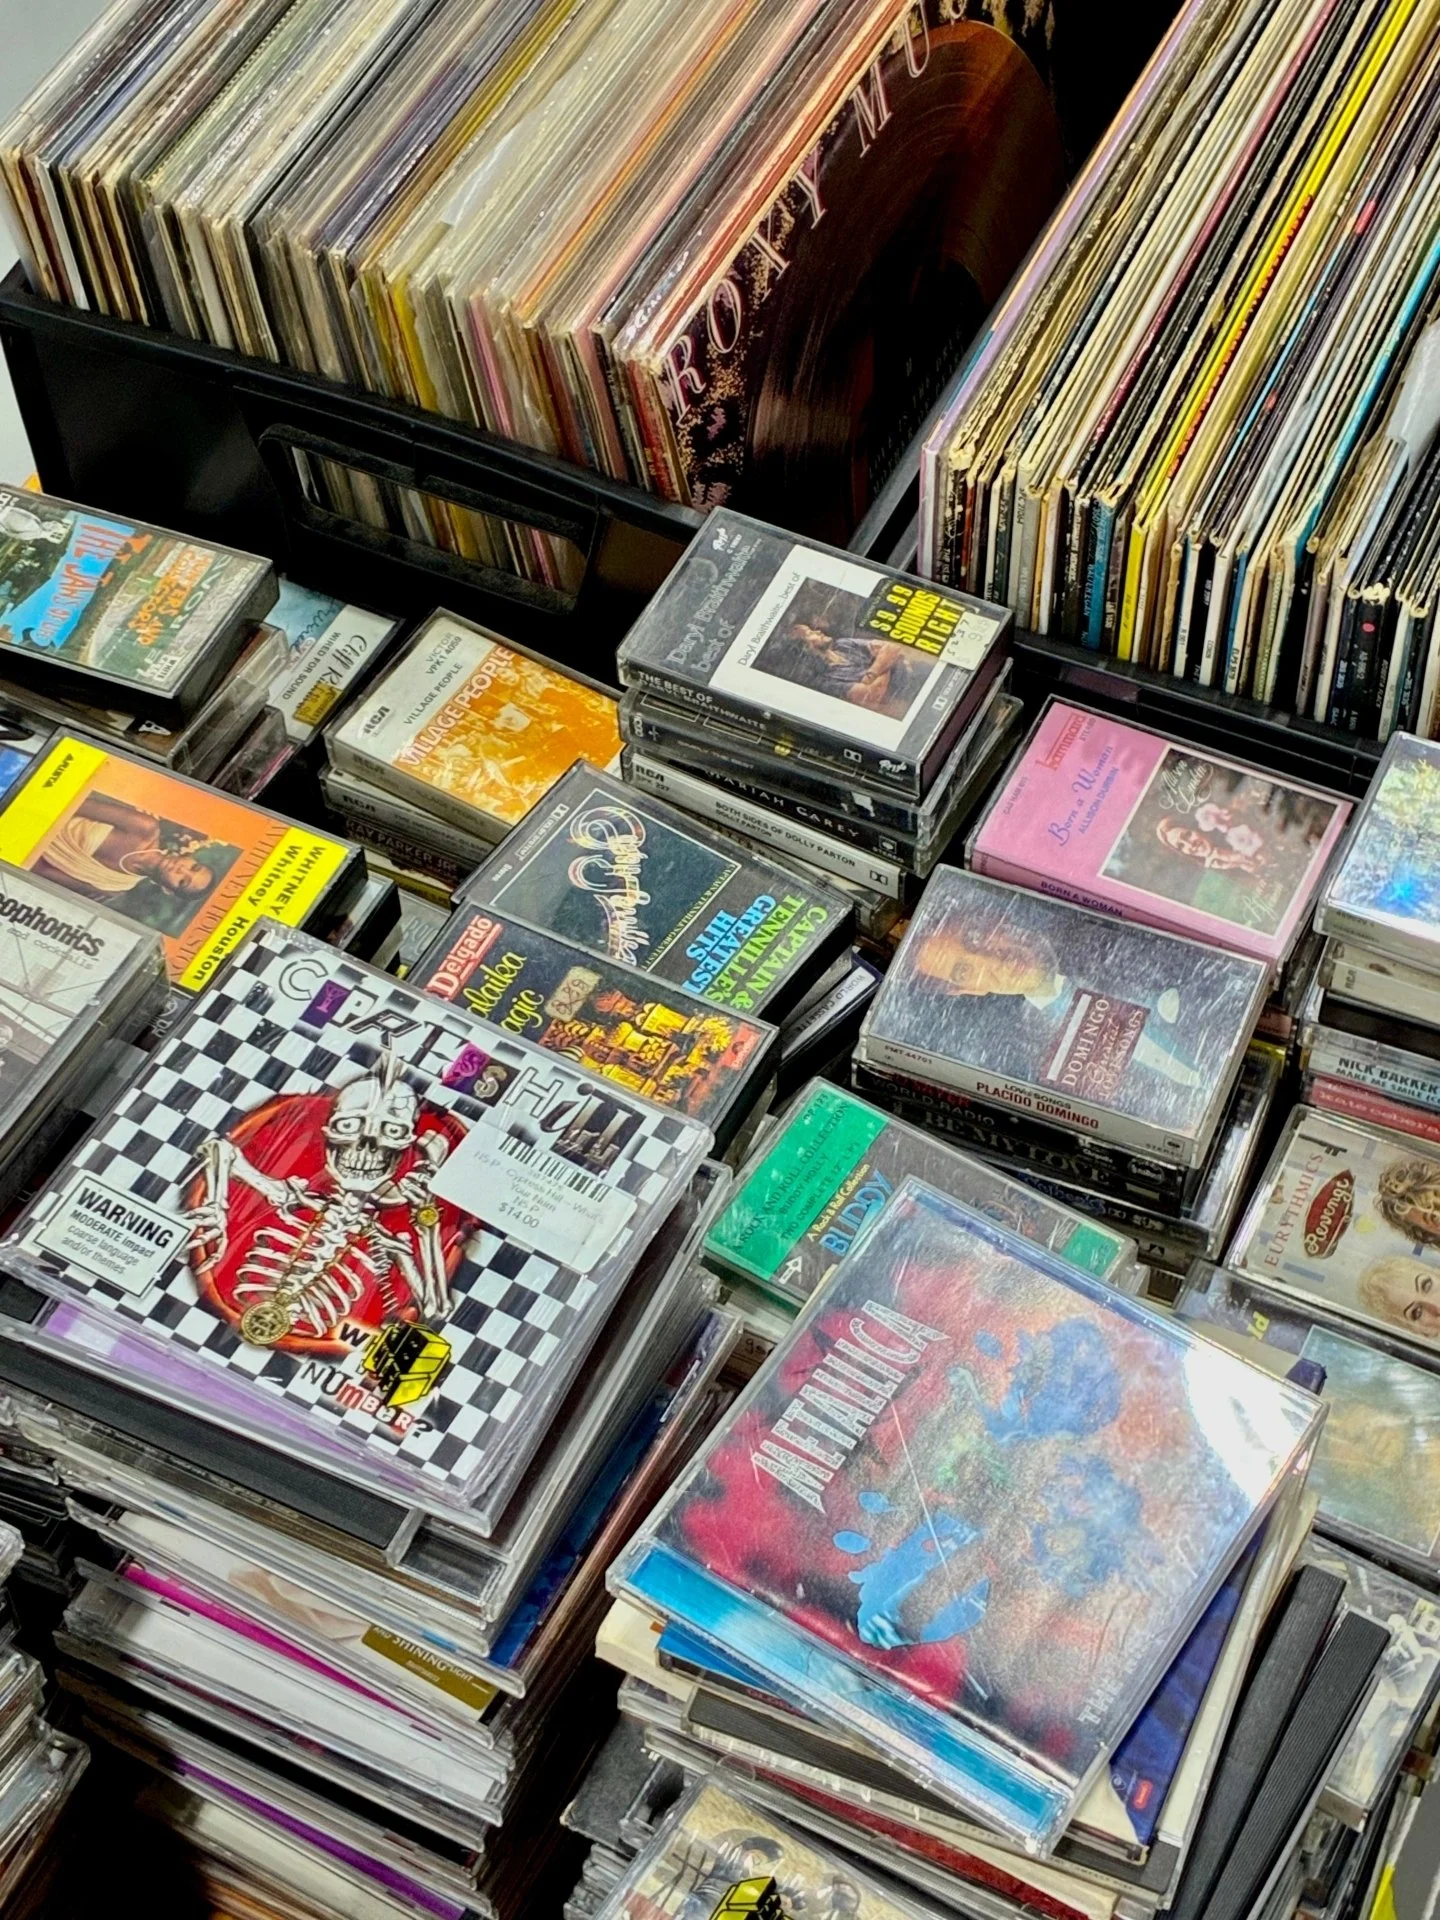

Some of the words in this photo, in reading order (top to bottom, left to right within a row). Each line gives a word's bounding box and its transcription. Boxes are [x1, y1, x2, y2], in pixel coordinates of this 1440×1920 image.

[737, 643, 757, 665] Daryl
[788, 571, 801, 581] of
[870, 583, 912, 632] $9.99
[890, 589, 939, 644] SOUNDS
[915, 598, 965, 654] RIGHT
[302, 655, 320, 674] FOR
[316, 630, 341, 657] WIRED
[328, 630, 372, 672] Cliff
[425, 632, 454, 663] VICTOR
[666, 622, 710, 666] Daryl
[689, 637, 726, 672] best
[711, 617, 738, 639] of
[281, 672, 306, 701] SOUND
[399, 702, 466, 768] VILLAGE
[461, 645, 515, 708] PEOPLE
[403, 691, 437, 725] VILLAGE
[433, 662, 463, 692] PEOPLE
[638, 671, 661, 685] THE
[663, 680, 692, 697] BEST
[695, 692, 713, 704] OF
[636, 764, 663, 782] RCA
[1042, 804, 1082, 846] Born
[1068, 740, 1114, 796] Woman
[1075, 797, 1103, 834] ALLISON
[1095, 766, 1120, 798] DURBIN
[715, 809, 739, 824] DOLLY
[740, 819, 772, 838] PARTON
[715, 801, 740, 818] BOTH
[743, 813, 769, 830] SIDES
[771, 825, 782, 836] OF
[785, 831, 814, 850] DOLLY
[816, 845, 855, 868] PARTON
[796, 804, 862, 840] CAREY
[243, 841, 303, 907] Whitney
[266, 843, 327, 915] WHITNEY
[1040, 880, 1071, 898] BORN
[1082, 896, 1122, 916] WOMAN
[187, 914, 251, 982] Houston
[429, 915, 500, 995] Delgado
[681, 909, 740, 962] HITS
[702, 892, 808, 1003] TENNILLE'S
[742, 904, 832, 994] CAPTAIN
[455, 944, 527, 1019] alaika
[727, 989, 759, 1012] &
[497, 985, 553, 1040] agic
[1061, 997, 1111, 1086] DOMINGO
[1031, 1092, 1072, 1110] SONGS
[1335, 1067, 1366, 1081] MAKE
[1370, 1078, 1386, 1087] ME
[1390, 1083, 1420, 1098] SMILE
[1339, 1056, 1373, 1075] NICK
[1379, 1068, 1439, 1096] BARKER
[974, 1081, 1033, 1107] PLACIDO
[1034, 1100, 1100, 1129] DOMINGO
[738, 1214, 765, 1243] ROCK
[761, 1190, 784, 1214] AND
[778, 1164, 803, 1192] ROLL
[799, 1101, 850, 1166] COLLECTION
[778, 1183, 806, 1215] BUDDY
[802, 1151, 830, 1184] HOLLY
[811, 1212, 830, 1232] Rock
[829, 1194, 845, 1210] Roll
[839, 1161, 870, 1197] Collection
[68, 1209, 124, 1242] MODERATE
[120, 1235, 156, 1259] impact
[73, 1187, 175, 1249] WARNING
[779, 1220, 799, 1241] TWO
[795, 1175, 833, 1222] COMPLETE
[1262, 1152, 1323, 1266] EURYTHMICS
[1303, 1177, 1351, 1258] Revenge
[60, 1235, 93, 1257] and/or
[90, 1251, 127, 1274] themes
[65, 1224, 99, 1245] coarse
[96, 1239, 140, 1267] language
[747, 1300, 950, 1511] METALLICA
